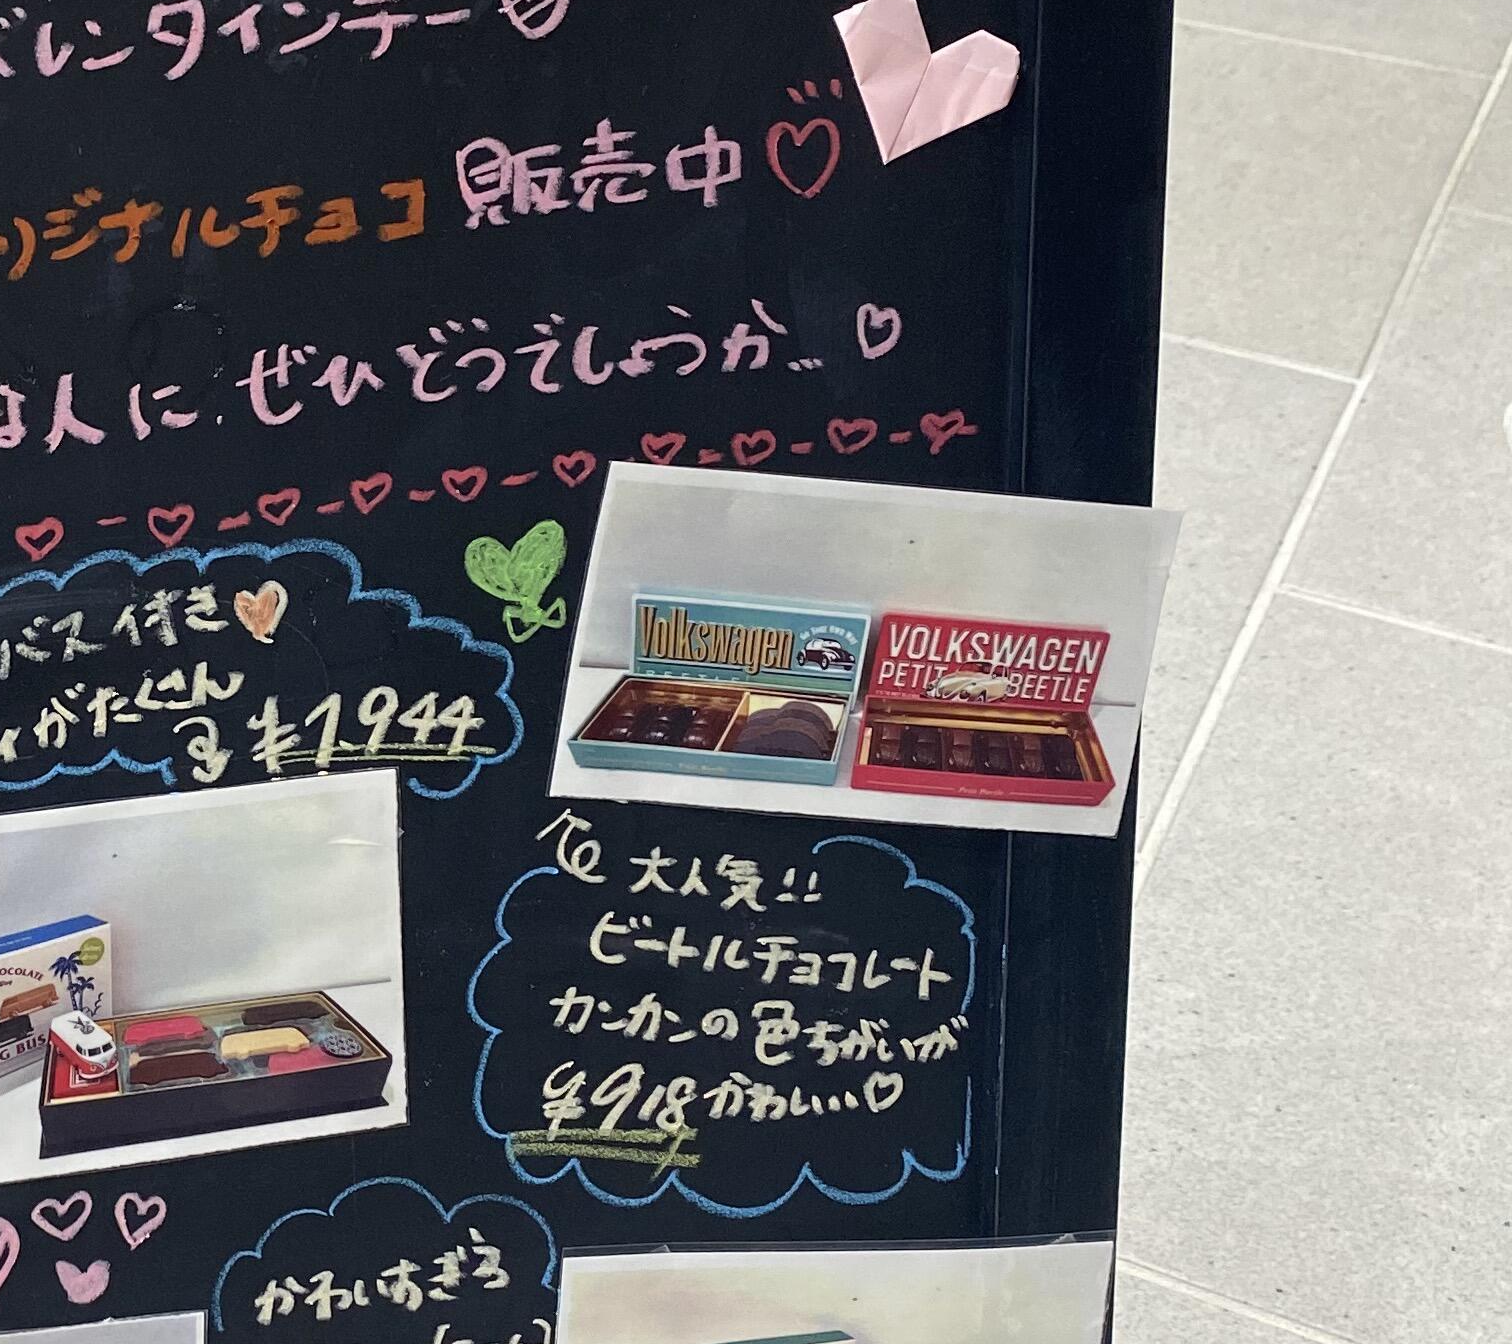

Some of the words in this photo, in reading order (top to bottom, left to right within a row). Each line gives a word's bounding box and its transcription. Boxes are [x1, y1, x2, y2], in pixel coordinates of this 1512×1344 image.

[639, 604, 795, 674] Volkswagen
[890, 623, 1103, 674] VOLKSWAGEN
[877, 660, 950, 689] PETIT
[1006, 671, 1091, 703] BEETLE
[16, 1033, 46, 1055] BUS
